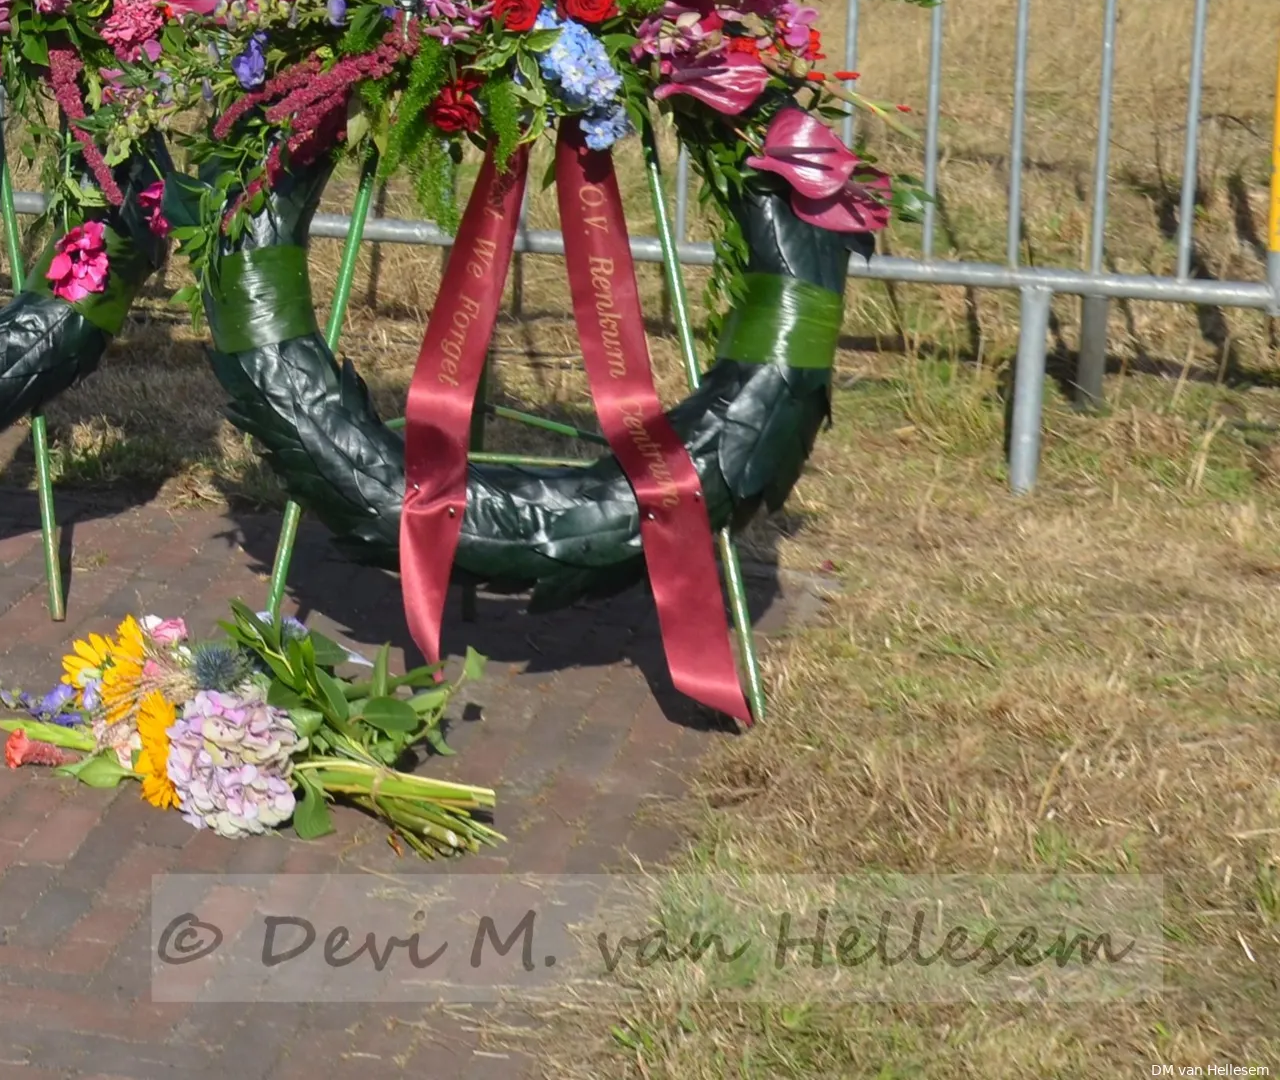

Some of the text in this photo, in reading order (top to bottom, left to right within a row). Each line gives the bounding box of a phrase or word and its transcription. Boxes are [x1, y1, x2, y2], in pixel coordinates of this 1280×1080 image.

[467, 237, 497, 279] We
[438, 294, 481, 387] Forget
[579, 184, 680, 508] O.V. Renkum Centrum
